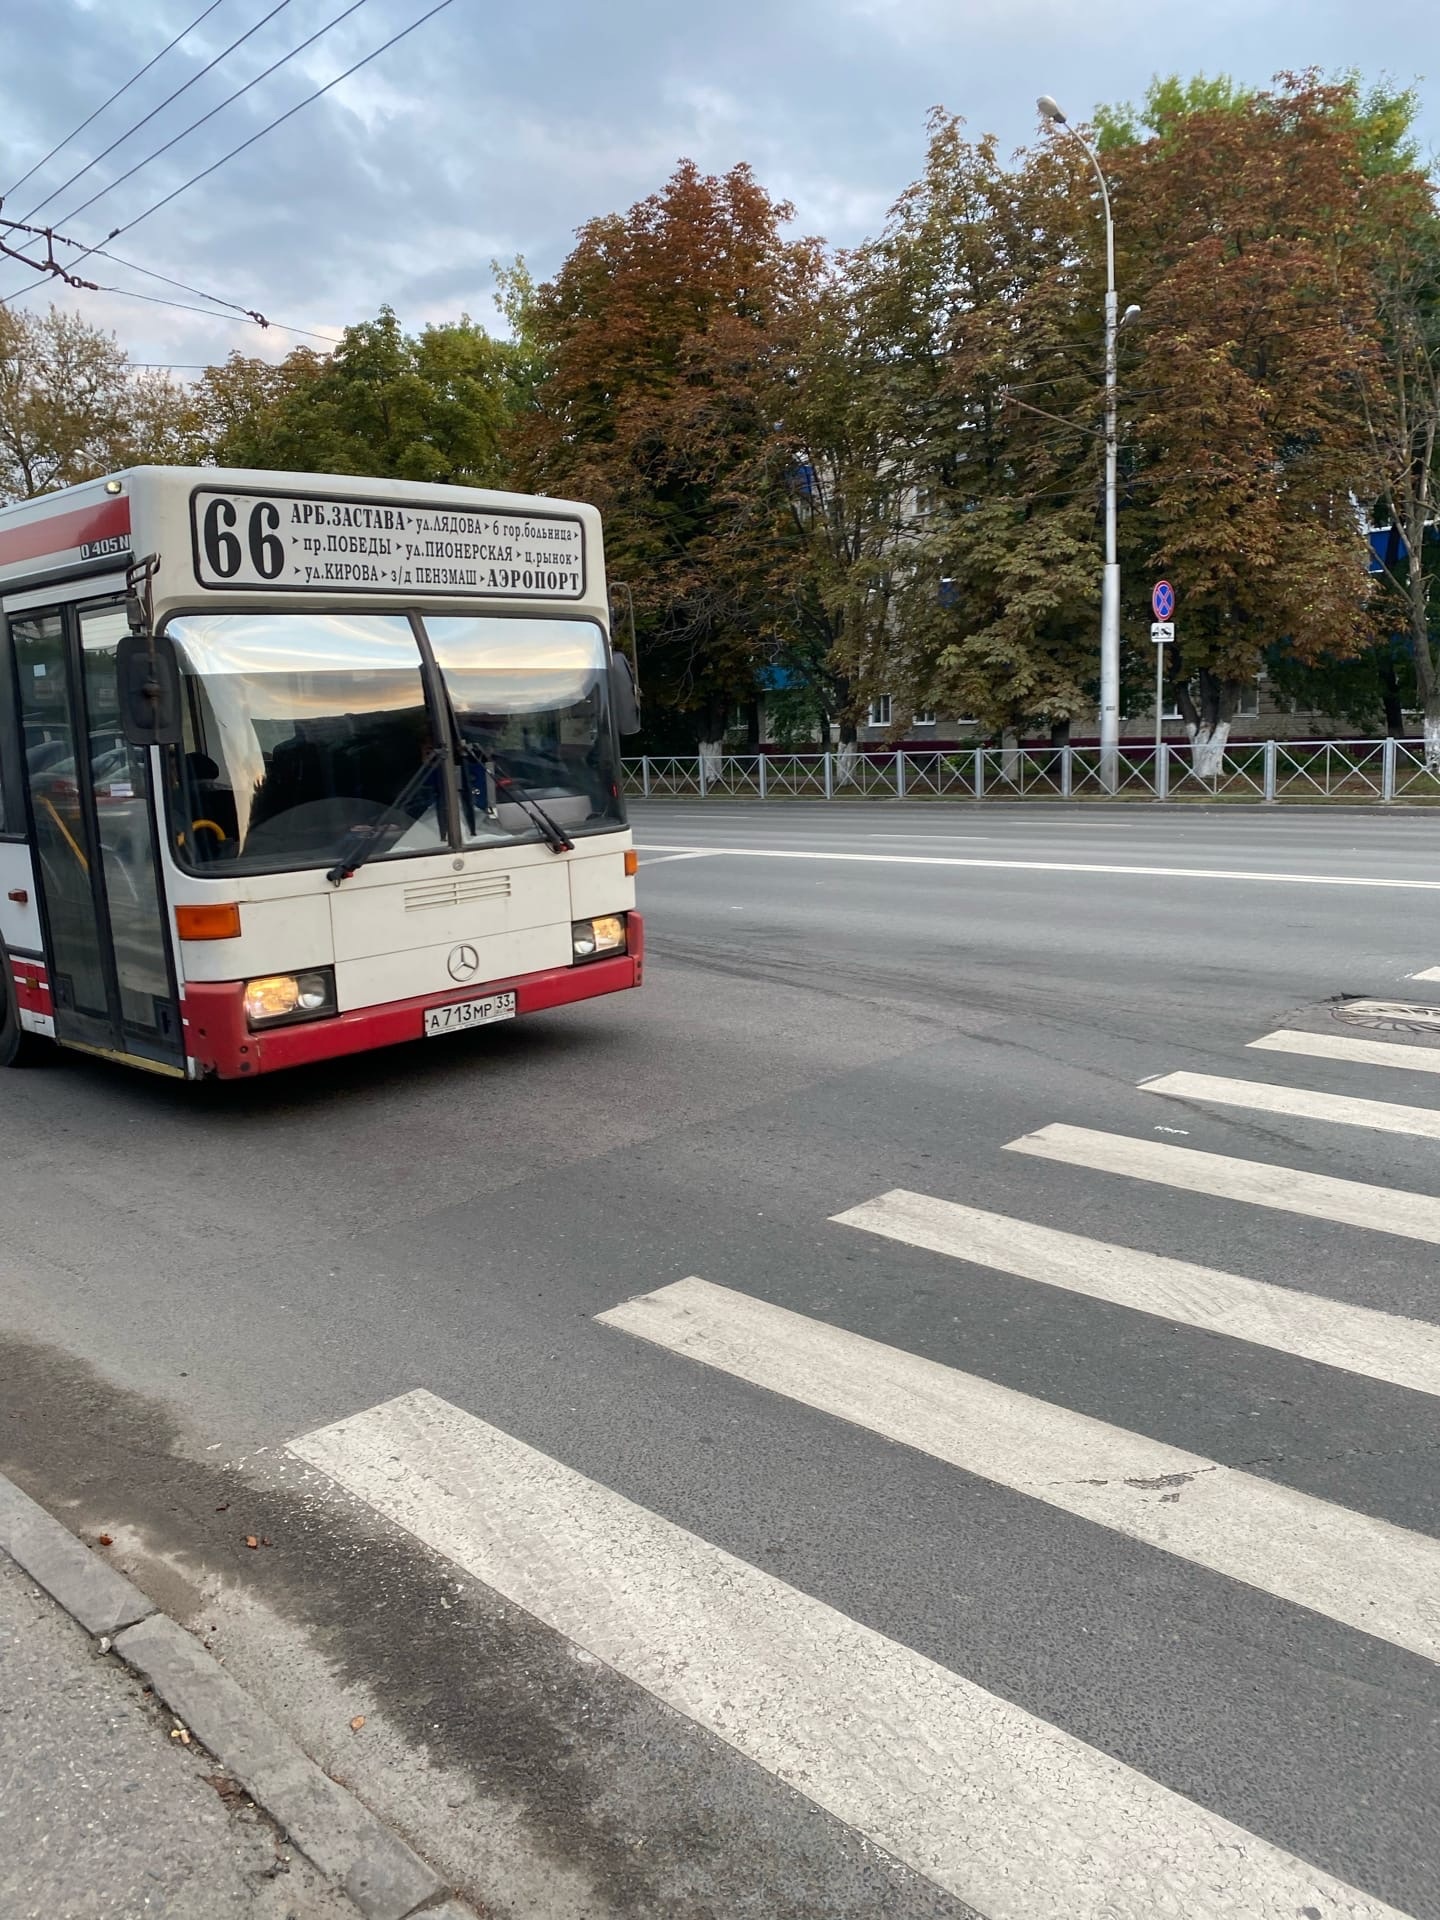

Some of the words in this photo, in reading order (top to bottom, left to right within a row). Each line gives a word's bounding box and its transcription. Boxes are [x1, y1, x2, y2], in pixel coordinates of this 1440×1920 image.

[204, 498, 285, 580] 66
[290, 503, 405, 531] АРБ.ЗАСТАВА
[416, 515, 482, 536] ул.ЛЯДОВА
[492, 520, 499, 535] 6
[503, 522, 572, 541] гор.больница
[303, 535, 392, 556] пр.ПОБЕДЫ
[405, 541, 513, 562] ул.ПИОНЕРСКАЯ
[525, 552, 572, 567] ц.рынок
[305, 563, 379, 583] ул.КИРОВА
[391, 566, 412, 585] з/д
[416, 567, 477, 585] ПЕНЗМАШ
[487, 568, 579, 591] АЭРОПОРТ
